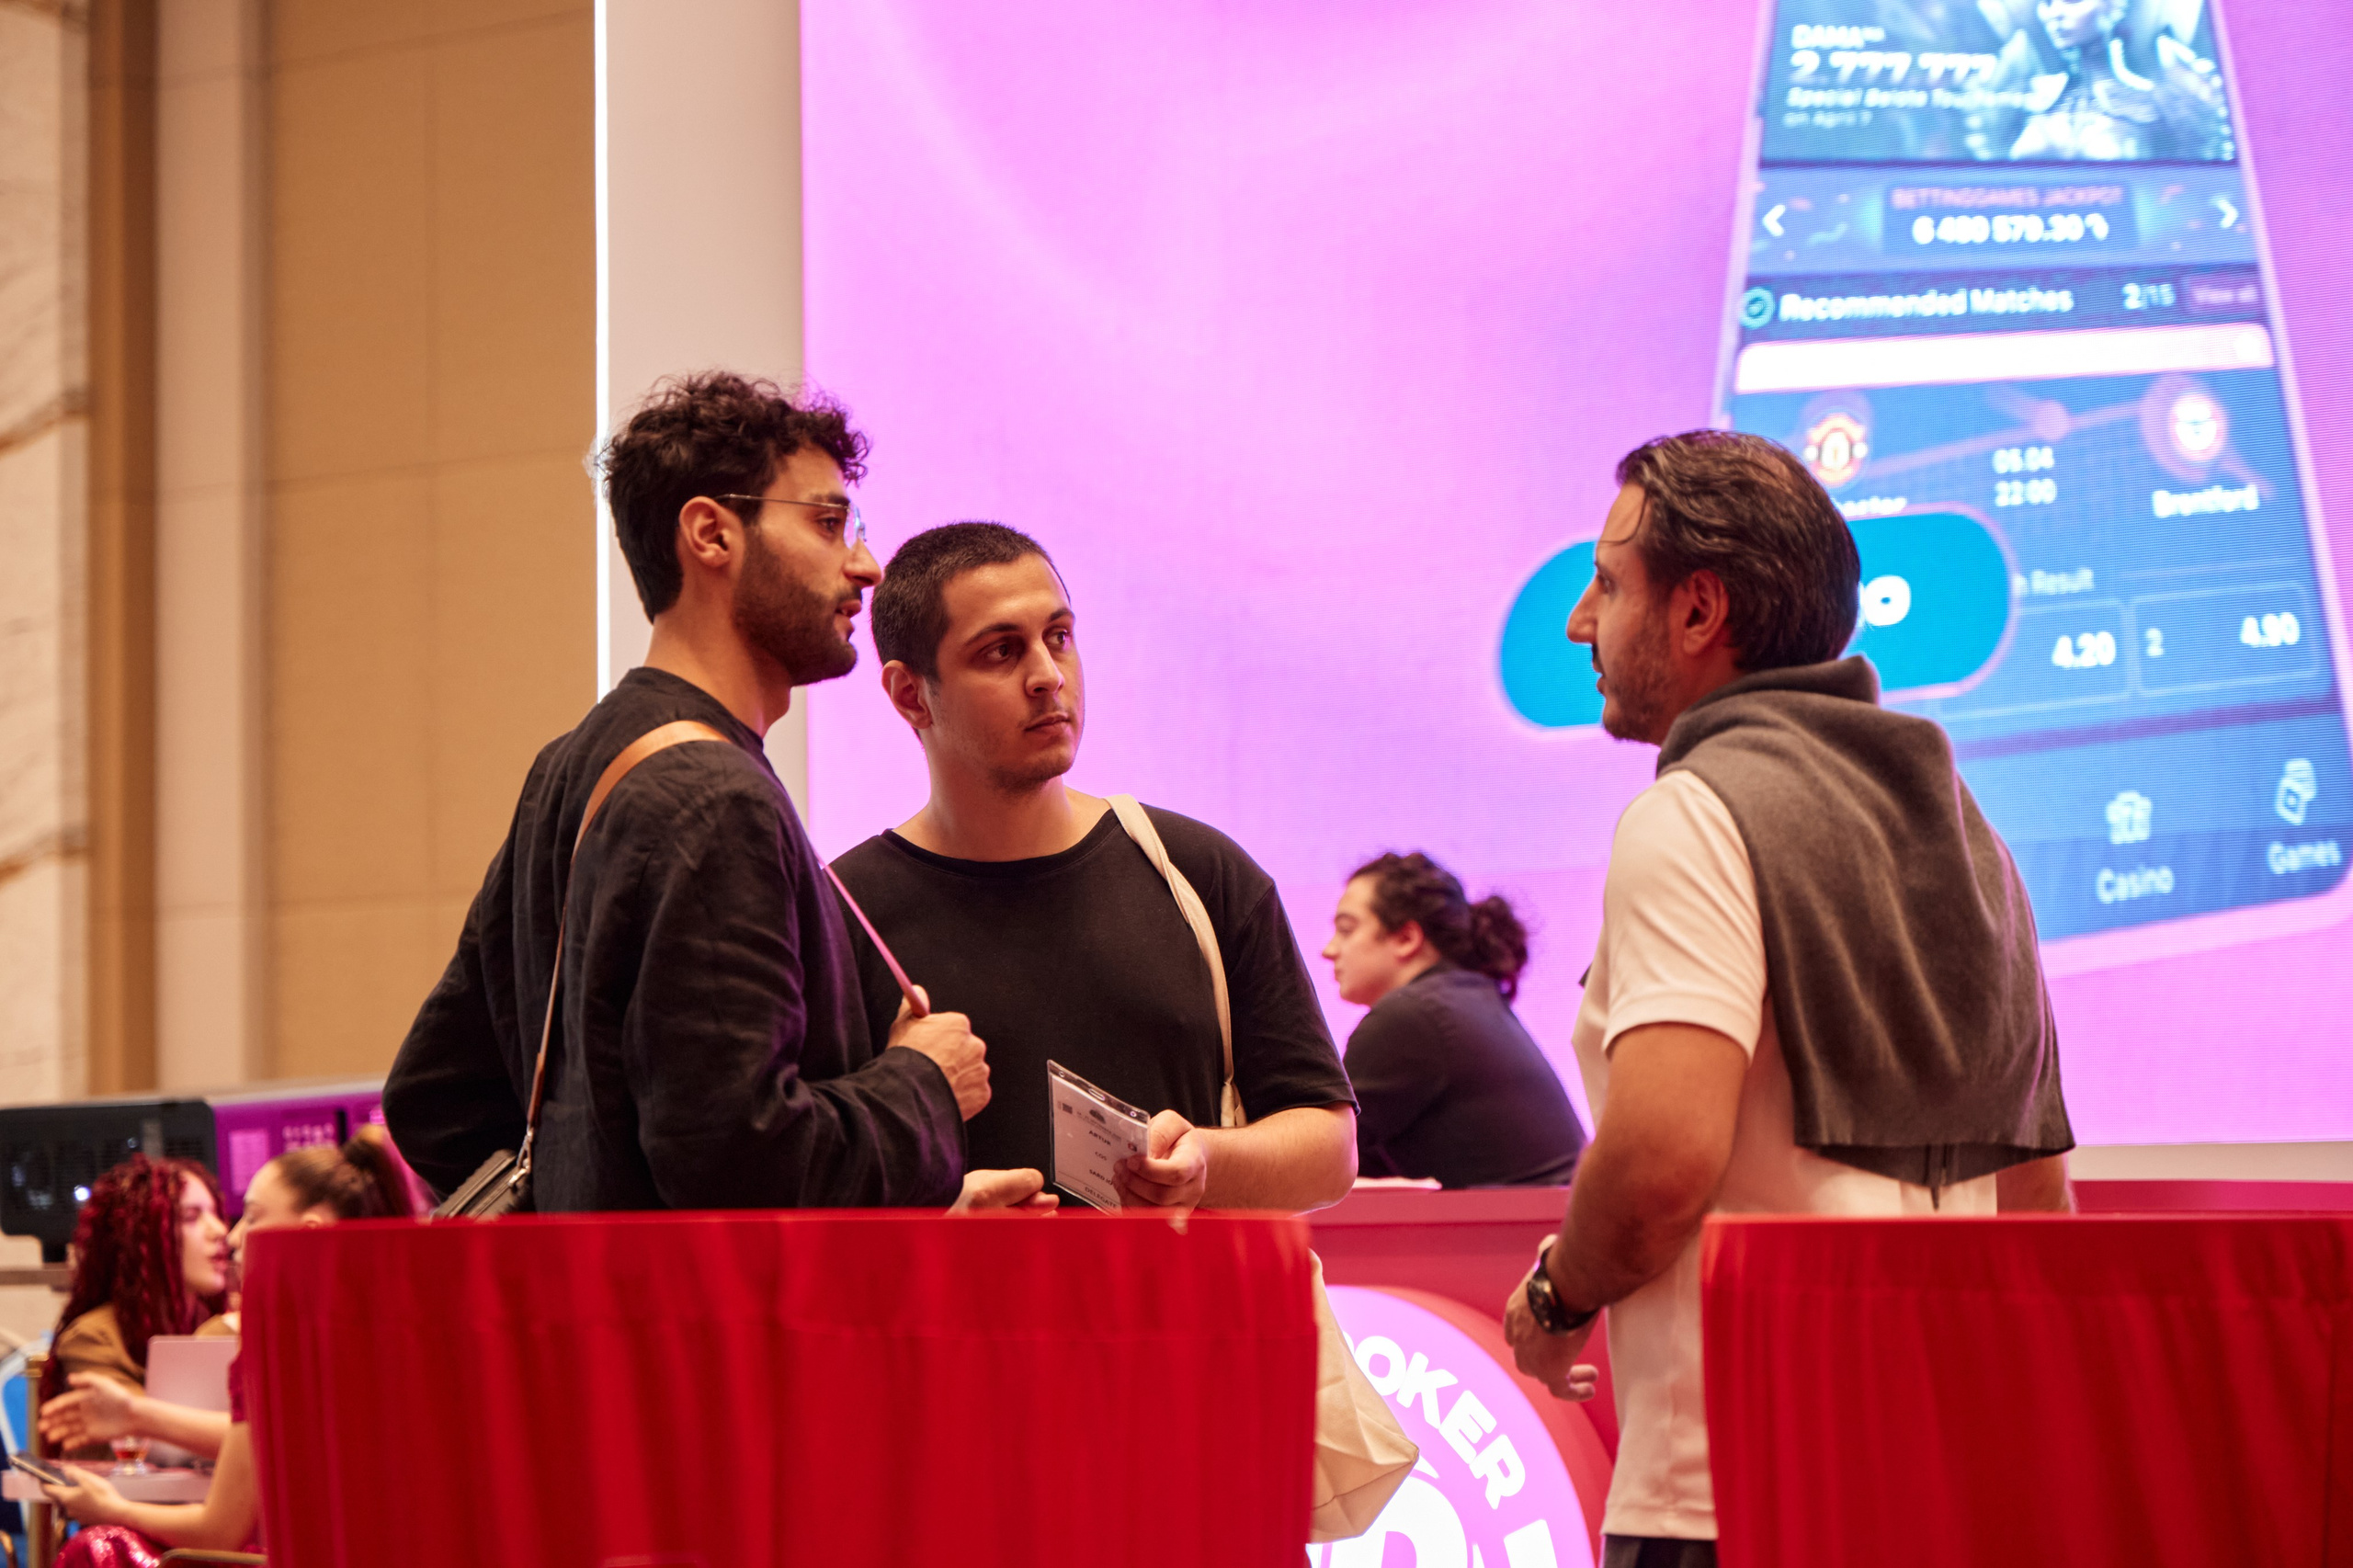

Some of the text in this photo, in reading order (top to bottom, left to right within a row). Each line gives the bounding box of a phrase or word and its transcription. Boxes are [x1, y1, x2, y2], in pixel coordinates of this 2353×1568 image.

[1779, 289, 1967, 322] Recommended
[1970, 287, 2074, 314] Matches
[1994, 478, 2057, 507] 22:00
[2152, 484, 2260, 517] Brentford
[2030, 567, 2095, 595] Result
[2051, 631, 2117, 669] 4.20
[2145, 629, 2165, 657] 2
[2268, 840, 2342, 875] Games
[2097, 866, 2175, 903] Casino
[1342, 1331, 1526, 1510] OKER
